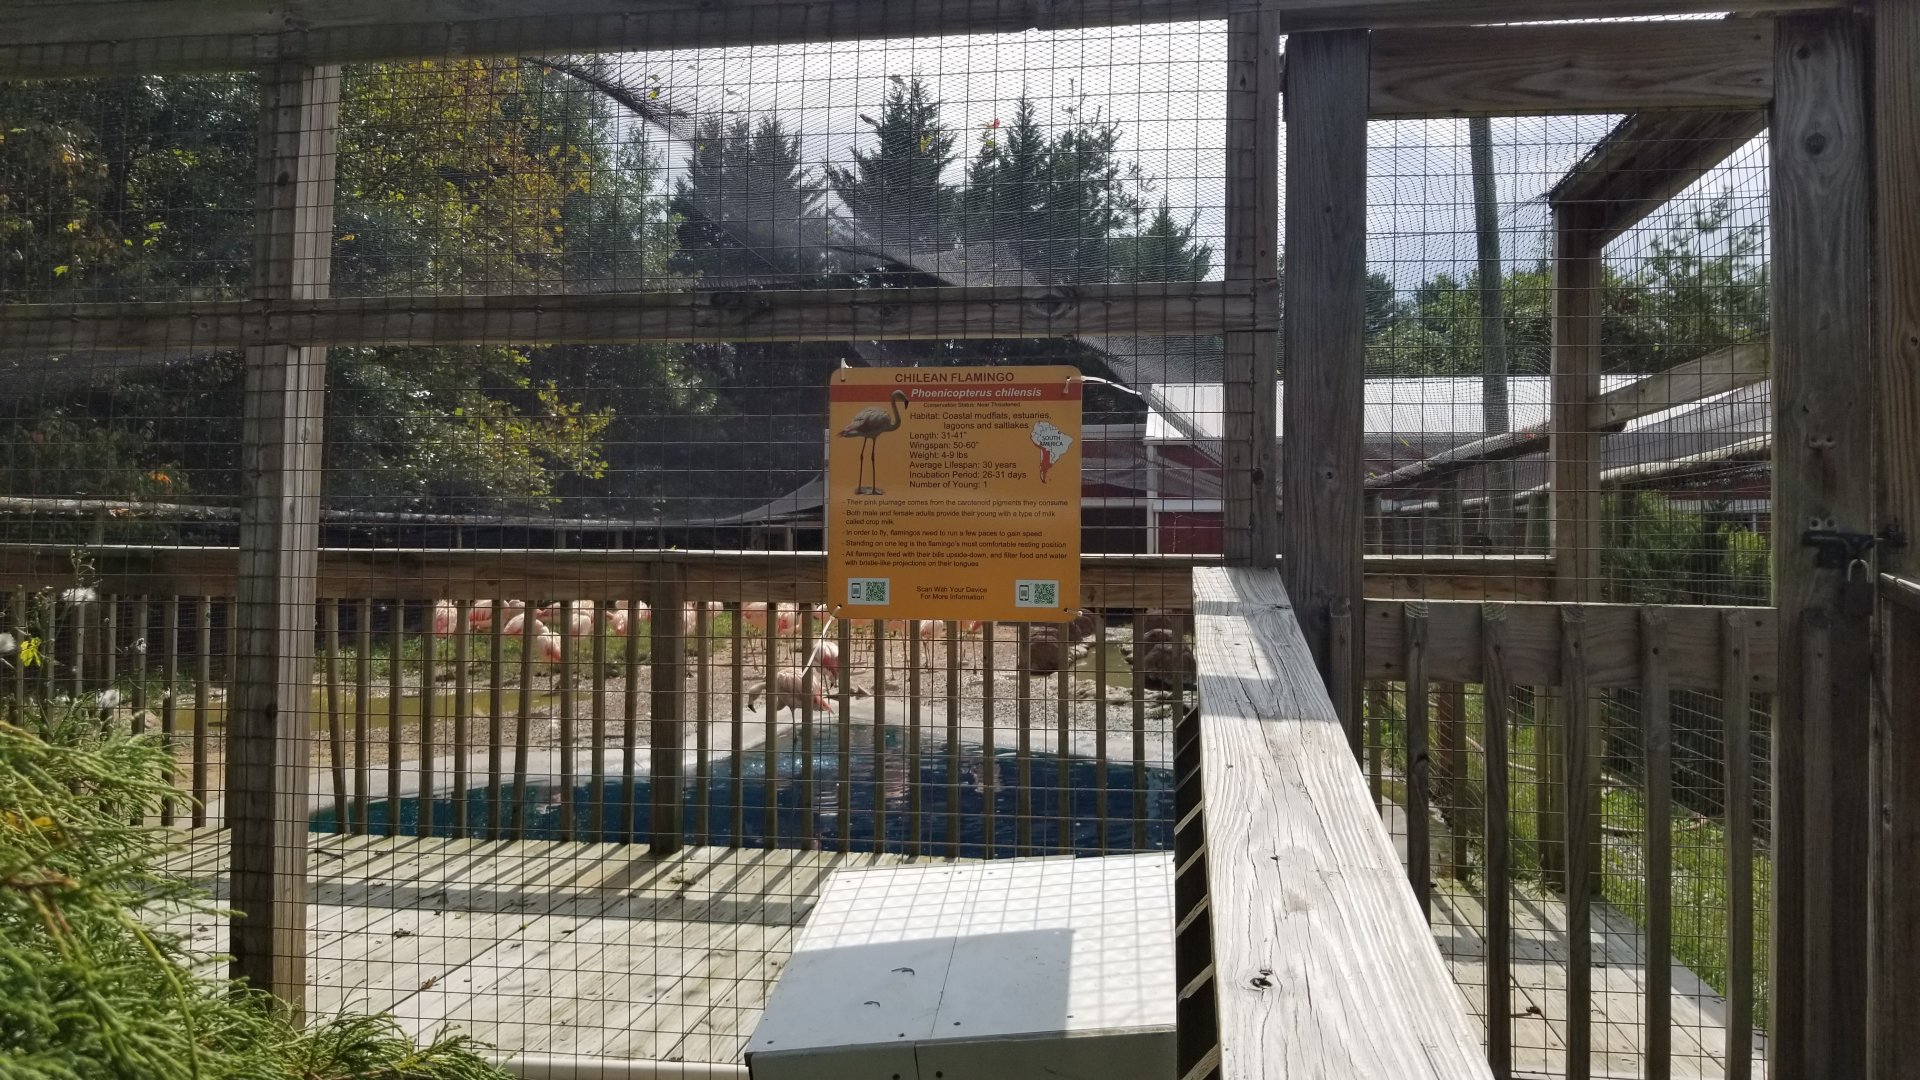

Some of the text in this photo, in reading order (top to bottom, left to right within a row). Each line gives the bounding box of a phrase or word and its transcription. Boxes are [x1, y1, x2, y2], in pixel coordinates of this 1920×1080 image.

[895, 372, 1014, 383] CHILEAN FLAMINGO
[911, 387, 1042, 399] Phoenicopterus chilensis
[910, 412, 1052, 421] Habitat: Coastal mudflats, estuaries,
[944, 422, 974, 430] lagoons
[994, 421, 1029, 429] saltlakes
[910, 432, 938, 441] Length:
[910, 441, 951, 450] Wingspan:
[910, 451, 968, 460] Weight: 4-9 lbs
[909, 461, 1017, 470] Average Lifespan: 30 years
[909, 471, 1026, 480] Incubation Period: 26-31 days
[952, 481, 979, 490] Young:
[879, 499, 905, 507] plumage
[992, 499, 1021, 507] pigments
[1023, 499, 1036, 507] they
[936, 510, 959, 518] provide
[1018, 510, 1032, 518] type
[880, 529, 888, 537] fly,
[890, 529, 920, 537] flamingos
[946, 551, 988, 559] upside-down,
[953, 560, 979, 568] tongues
